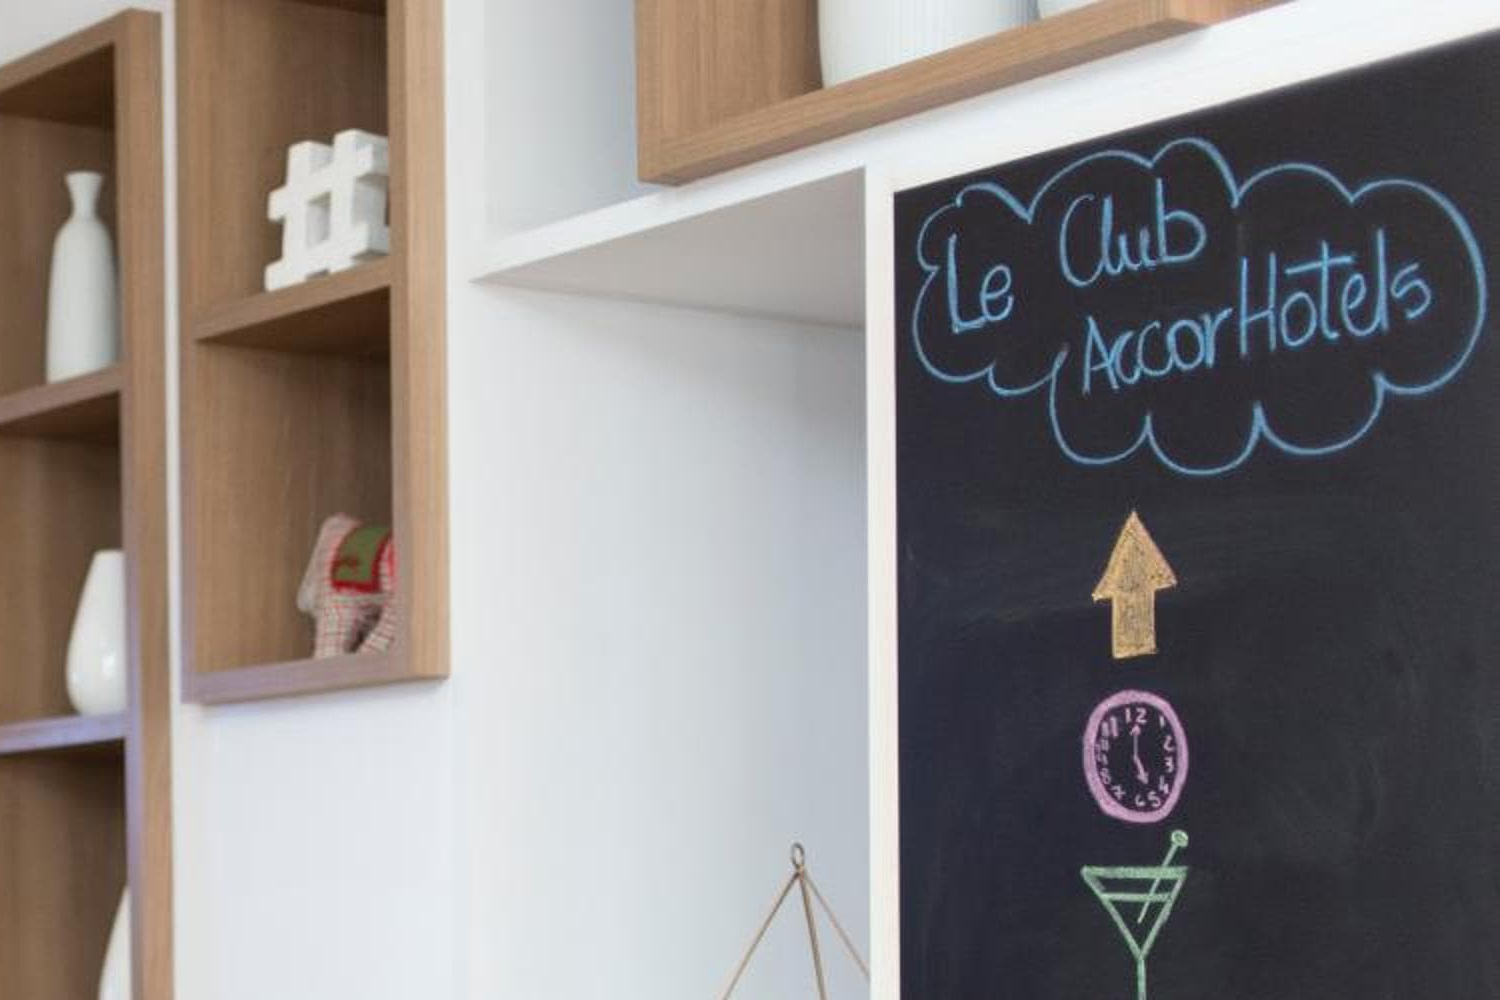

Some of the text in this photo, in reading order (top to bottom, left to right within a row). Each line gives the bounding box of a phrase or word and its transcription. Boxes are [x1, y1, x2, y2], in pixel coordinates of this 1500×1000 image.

[946, 177, 1208, 335] Le Club
[1125, 707, 1148, 725] 12
[1163, 735, 1175, 752] 2
[1164, 756, 1175, 774] 3
[1158, 775, 1170, 795] 4
[1147, 790, 1162, 808] 5
